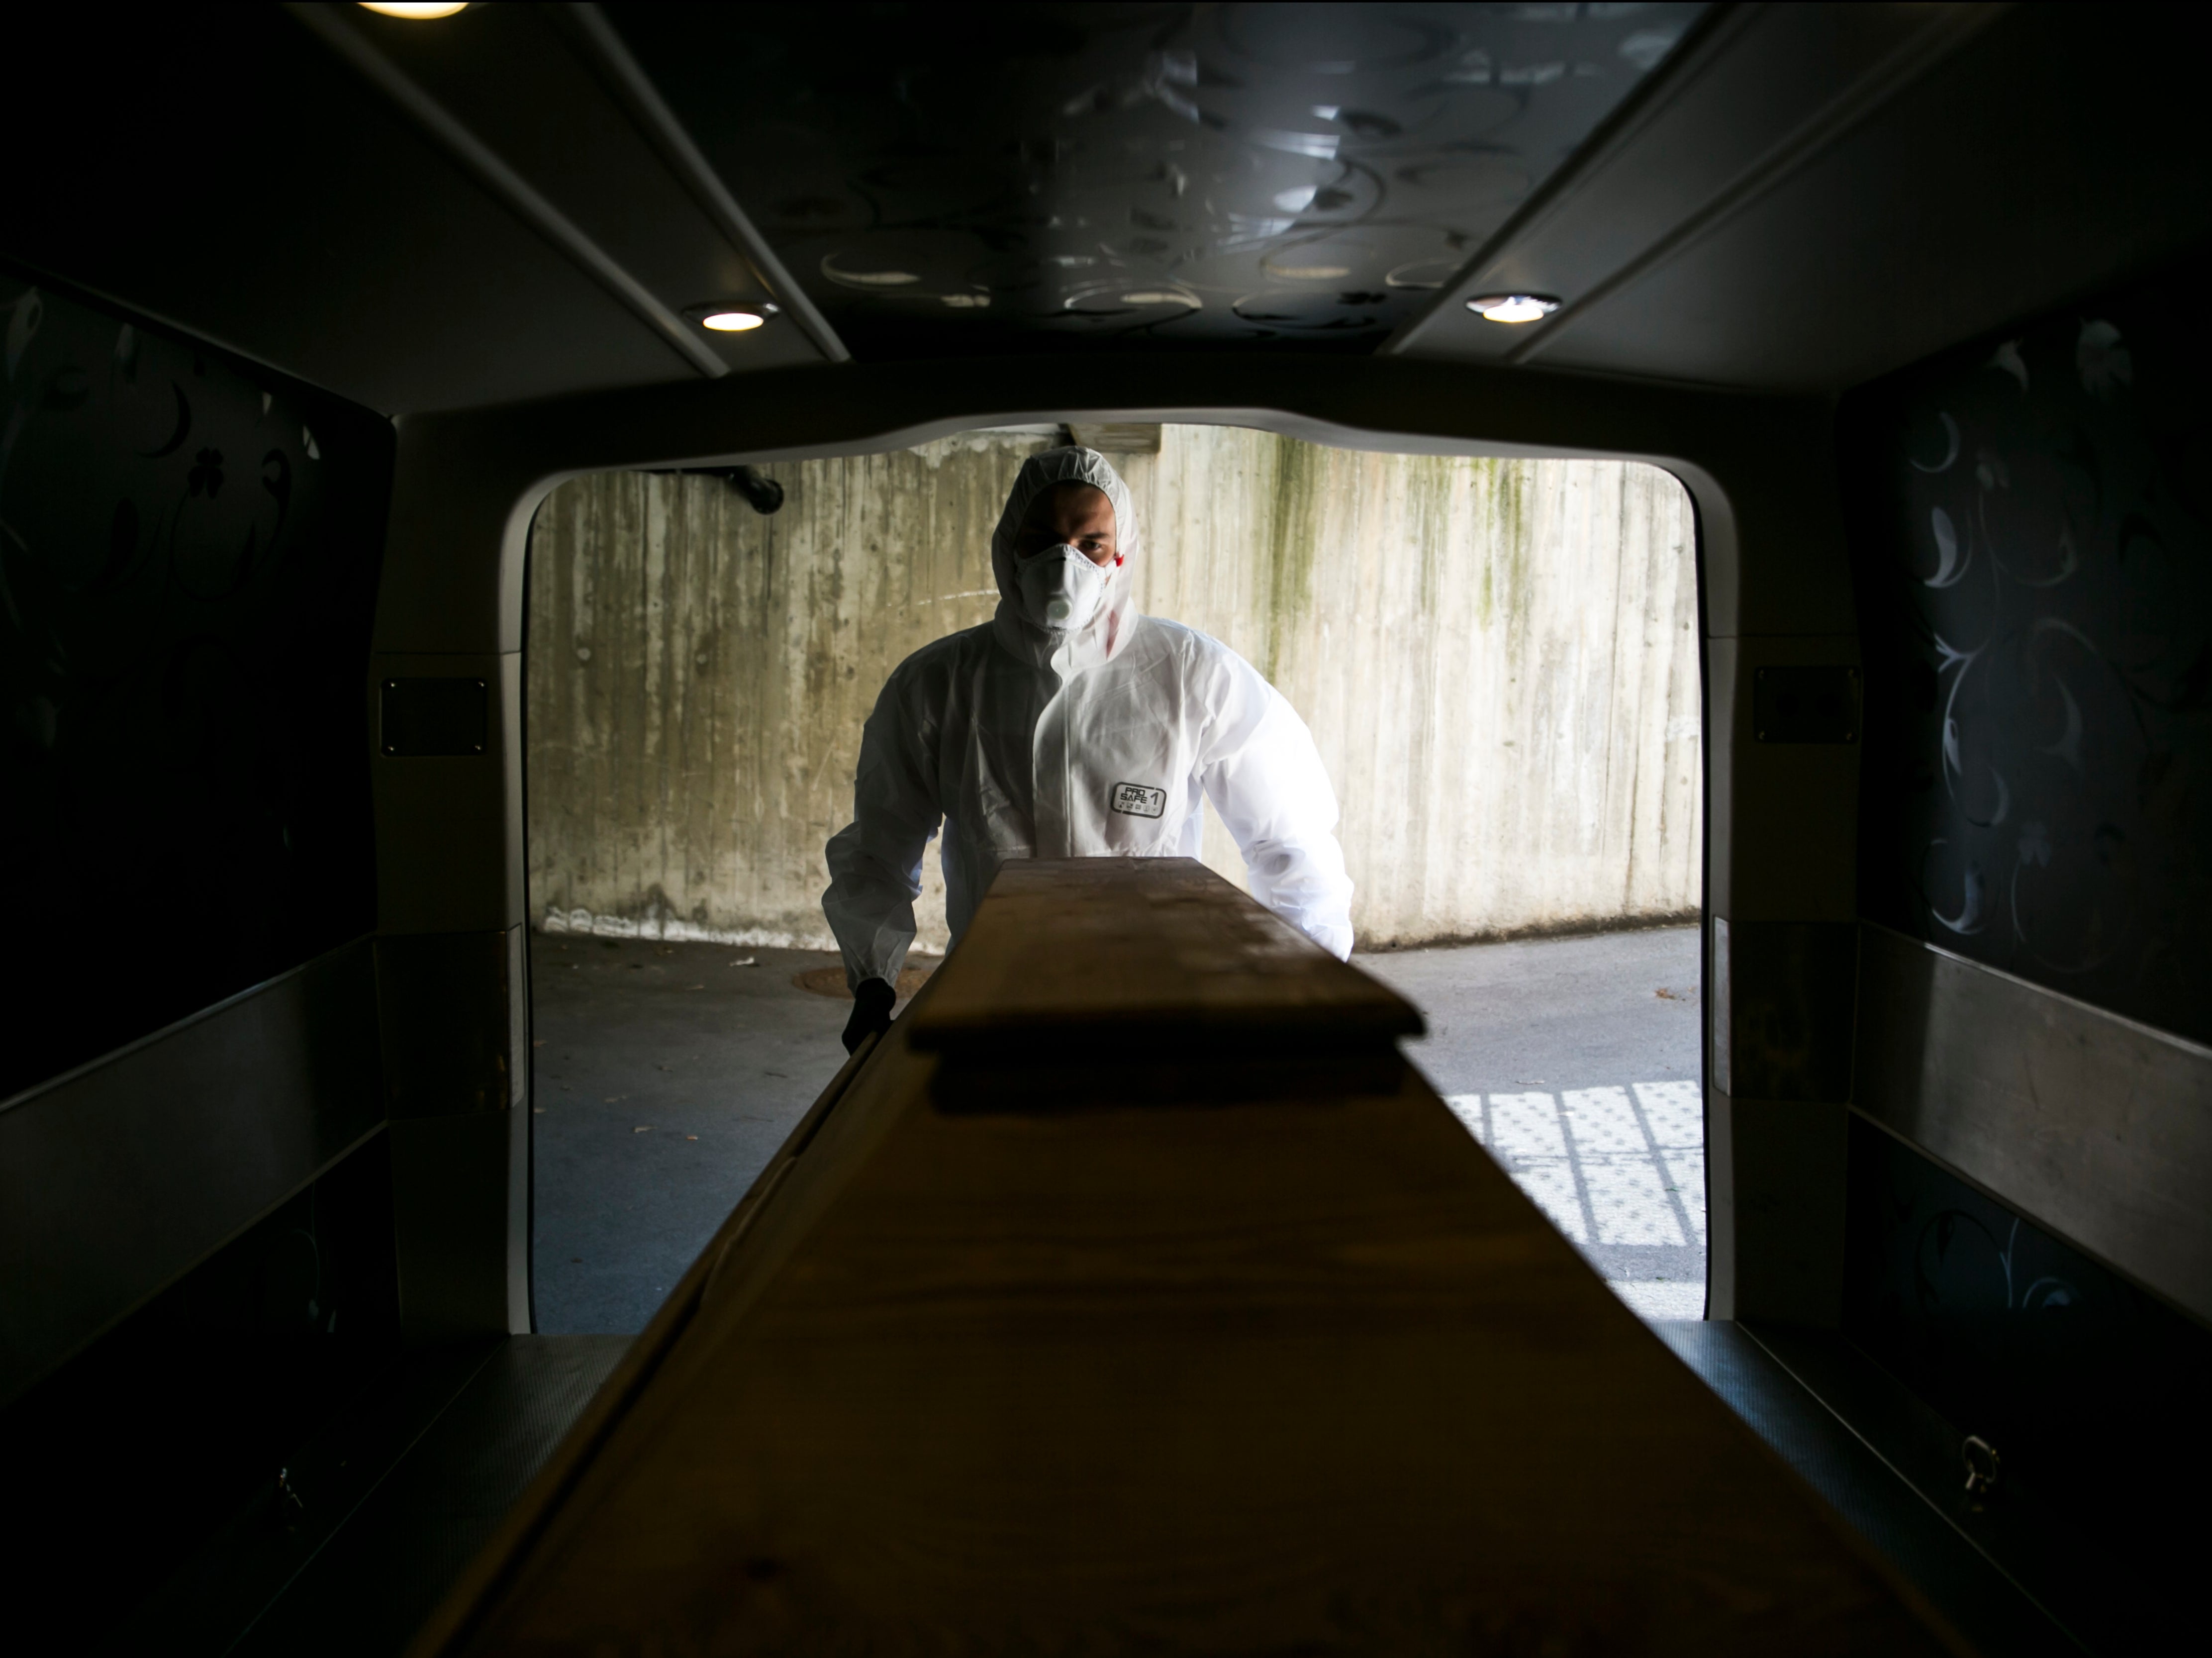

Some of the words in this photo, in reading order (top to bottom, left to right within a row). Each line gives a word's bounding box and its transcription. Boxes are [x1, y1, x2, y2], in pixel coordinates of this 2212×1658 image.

[1125, 787, 1146, 796] PRO
[1120, 793, 1148, 803] SAFE
[1151, 792, 1158, 805] 1
